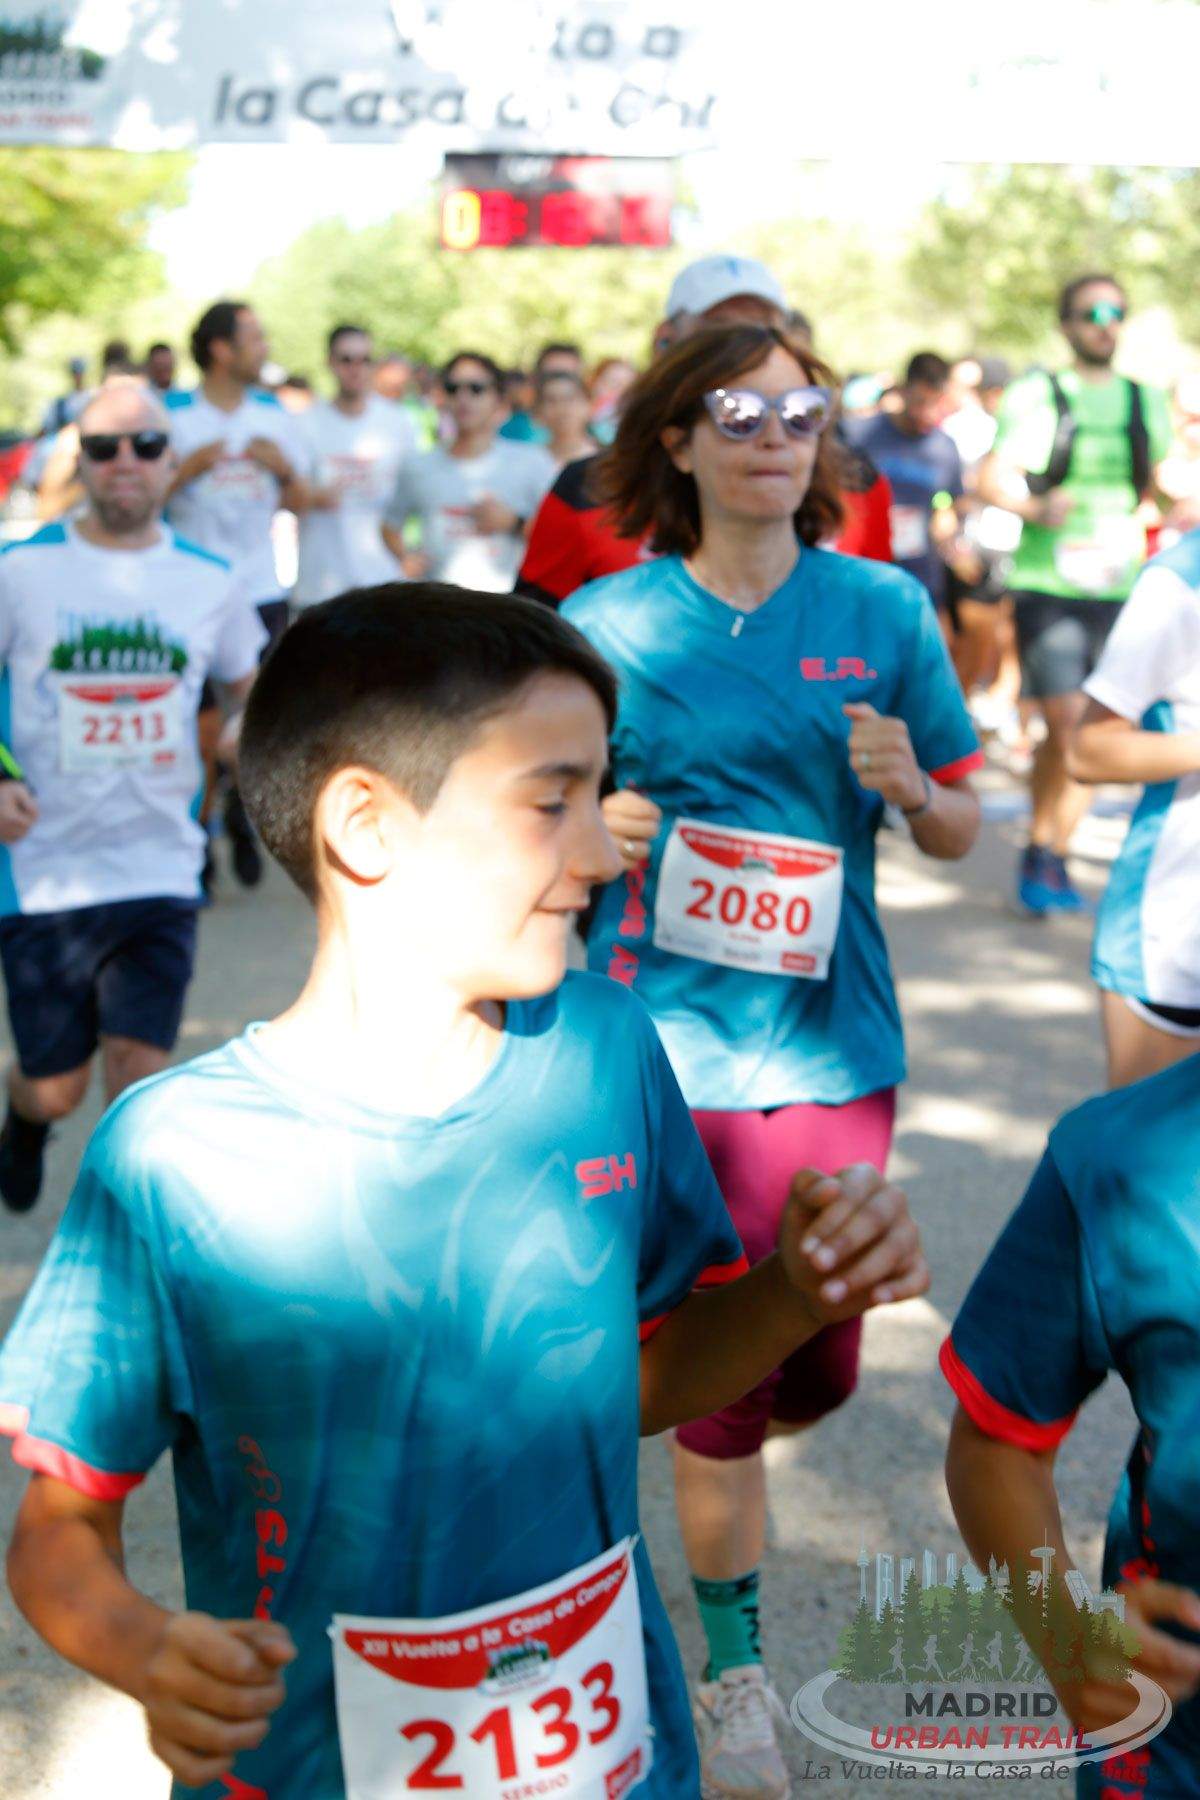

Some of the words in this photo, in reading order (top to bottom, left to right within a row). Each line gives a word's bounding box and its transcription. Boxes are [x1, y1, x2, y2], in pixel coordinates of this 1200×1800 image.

[213, 73, 279, 127] la
[296, 76, 465, 127] Casa
[84, 713, 166, 745] 2213
[686, 878, 812, 937] 2080
[575, 1151, 637, 1199] SH
[391, 1639, 460, 1659] Vuelta
[508, 1609, 553, 1637] Casa
[399, 1662, 621, 1789] 2133
